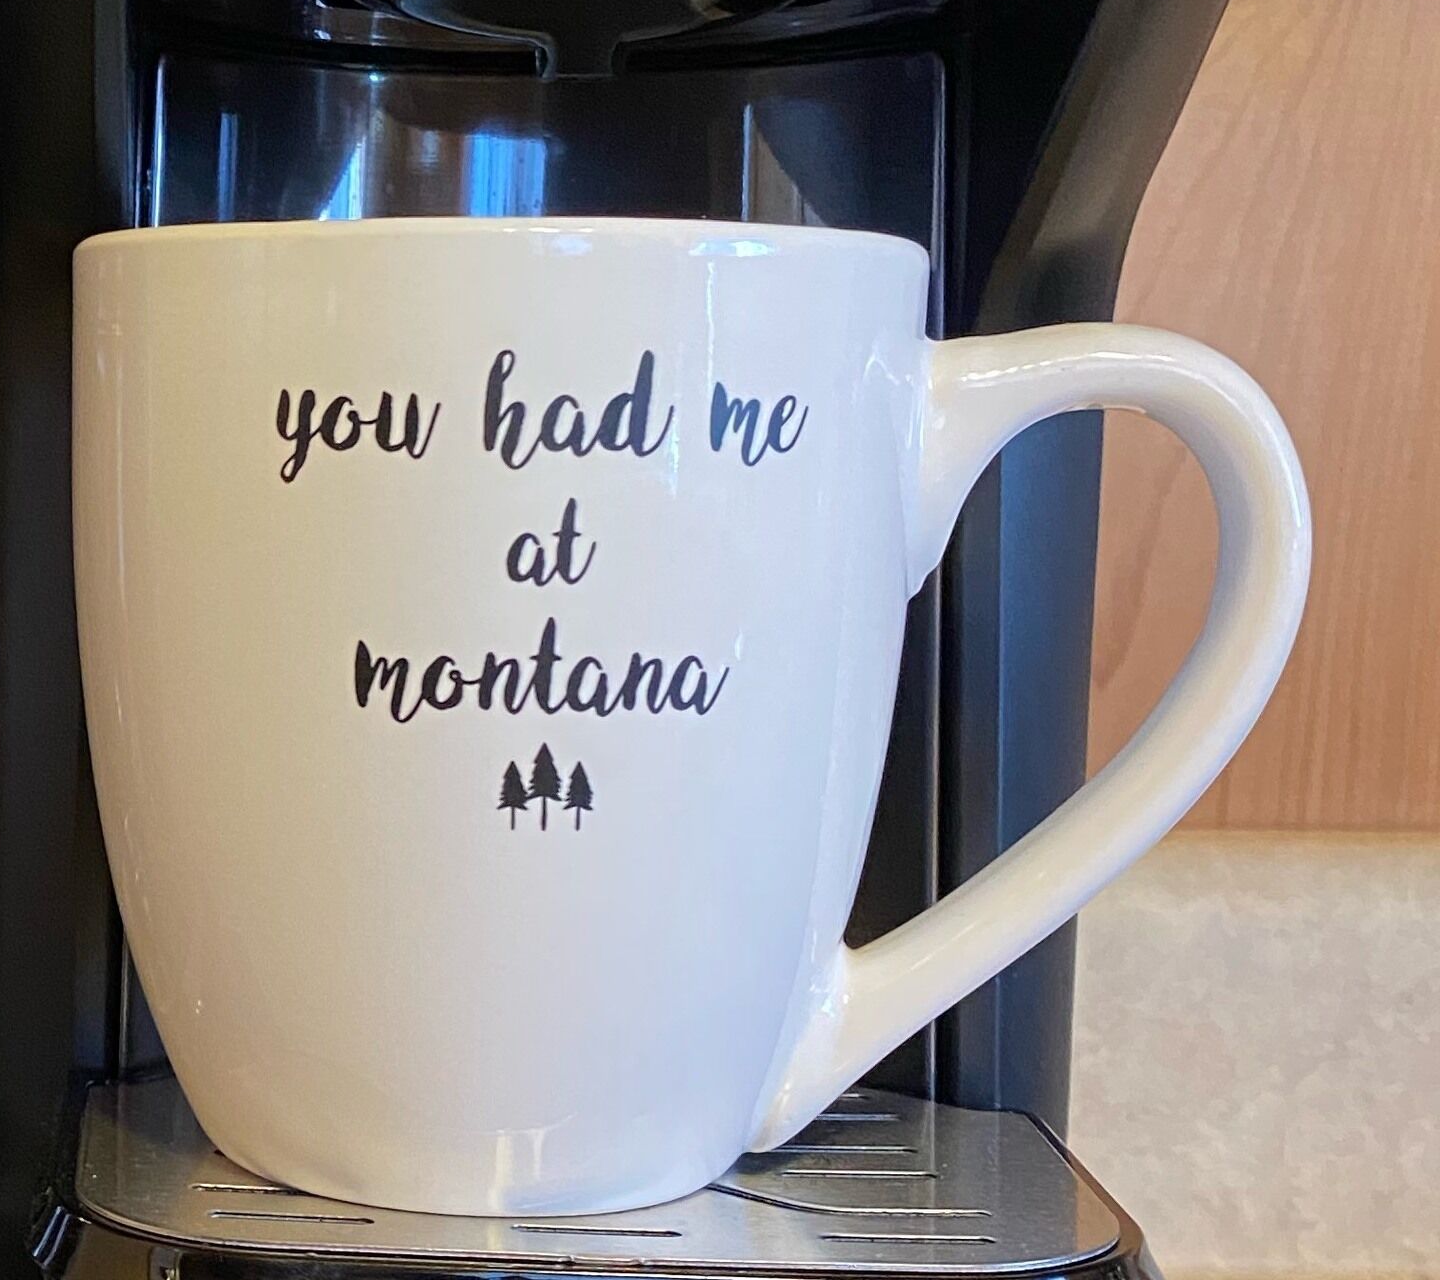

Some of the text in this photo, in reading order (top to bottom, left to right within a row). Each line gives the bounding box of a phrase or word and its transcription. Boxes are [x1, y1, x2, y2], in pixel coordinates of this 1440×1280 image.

[275, 349, 809, 483] you had me
[505, 497, 597, 587] at
[354, 616, 730, 723] montana
